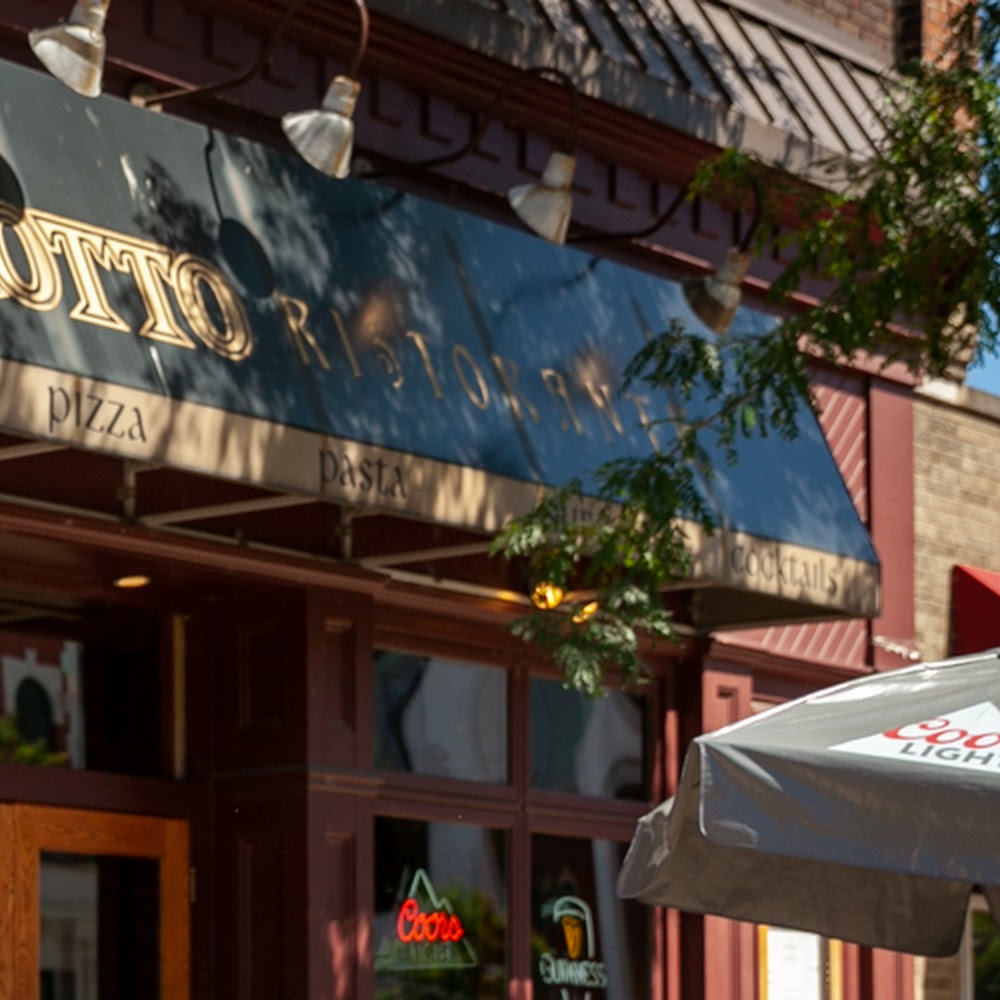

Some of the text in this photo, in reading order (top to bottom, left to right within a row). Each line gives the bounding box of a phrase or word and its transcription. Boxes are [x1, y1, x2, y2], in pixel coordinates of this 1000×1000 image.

[48, 386, 147, 443] pizza
[319, 449, 408, 498] pasta
[730, 544, 838, 597] cocktails
[900, 742, 1000, 769] LIGH
[396, 897, 466, 944] Coors
[538, 951, 608, 988] GUINNESS
